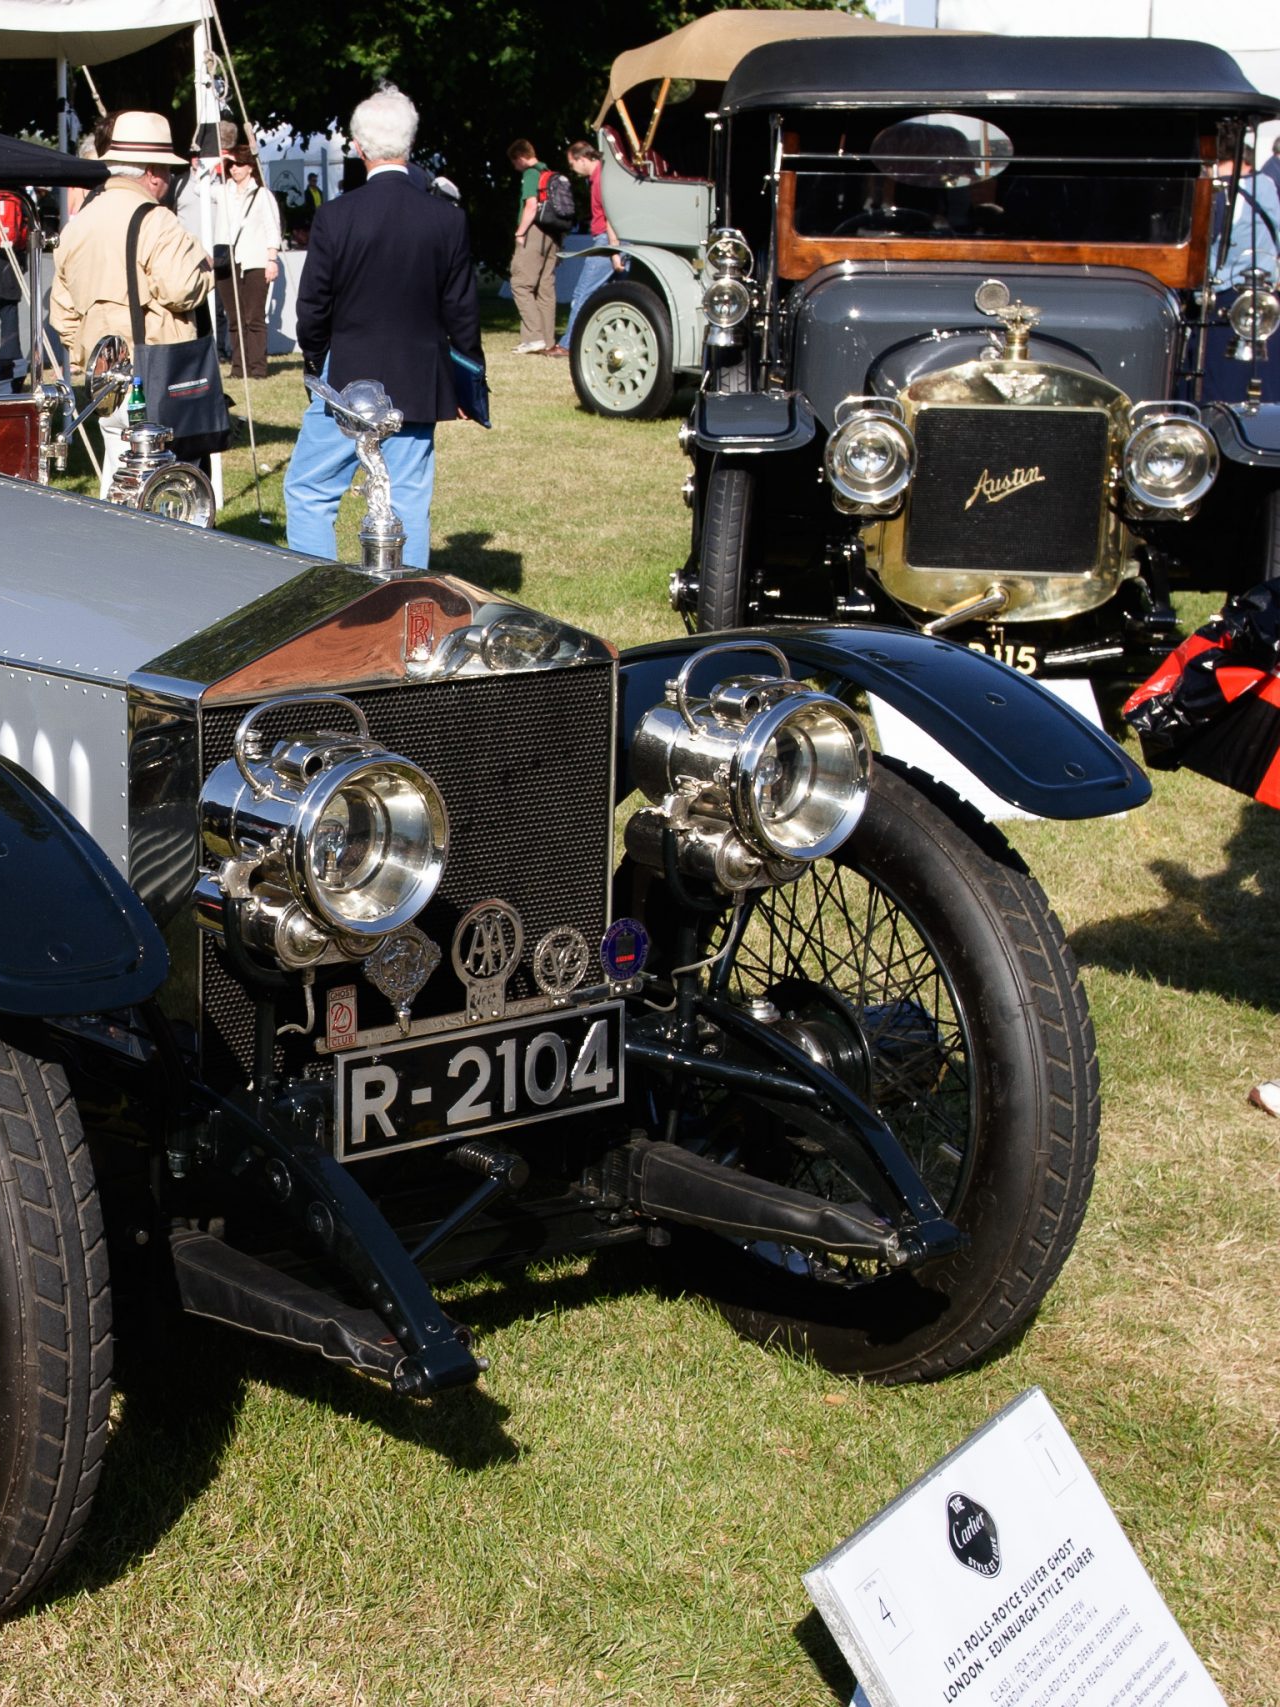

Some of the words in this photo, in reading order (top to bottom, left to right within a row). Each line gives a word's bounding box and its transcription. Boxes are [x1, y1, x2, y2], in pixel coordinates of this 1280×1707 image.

[965, 466, 1045, 511] Austin
[330, 989, 354, 1000] GHOST
[331, 1036, 354, 1048] CLUB
[949, 1496, 965, 1514] THE
[952, 1511, 985, 1549] Cartier
[967, 1556, 990, 1575] STYLE
[878, 1596, 896, 1628] 4
[943, 1647, 967, 1674] 1912
[964, 1591, 1022, 1654] ROLLS-ROYCE
[1020, 1565, 1050, 1598] SILVER
[1047, 1538, 1076, 1570] GHOST
[942, 1660, 985, 1704] LONDON
[990, 1602, 1040, 1658] EDINBURGH
[1037, 1577, 1064, 1610] STYLE
[1061, 1547, 1095, 1584] TOURER
[1112, 1622, 1143, 1659] BERKSHIRE
[990, 1677, 1012, 1702] CLASS
[1014, 1657, 1030, 1674] FOR
[1026, 1644, 1042, 1662] THE
[1039, 1611, 1073, 1650] PRIVILEGED
[1026, 1650, 1056, 1682] TOURING
[1031, 1668, 1071, 1707] OLLS-ROYCE
[1068, 1658, 1079, 1674] OF
[1095, 1603, 1131, 1645] DERBYSHIRE
